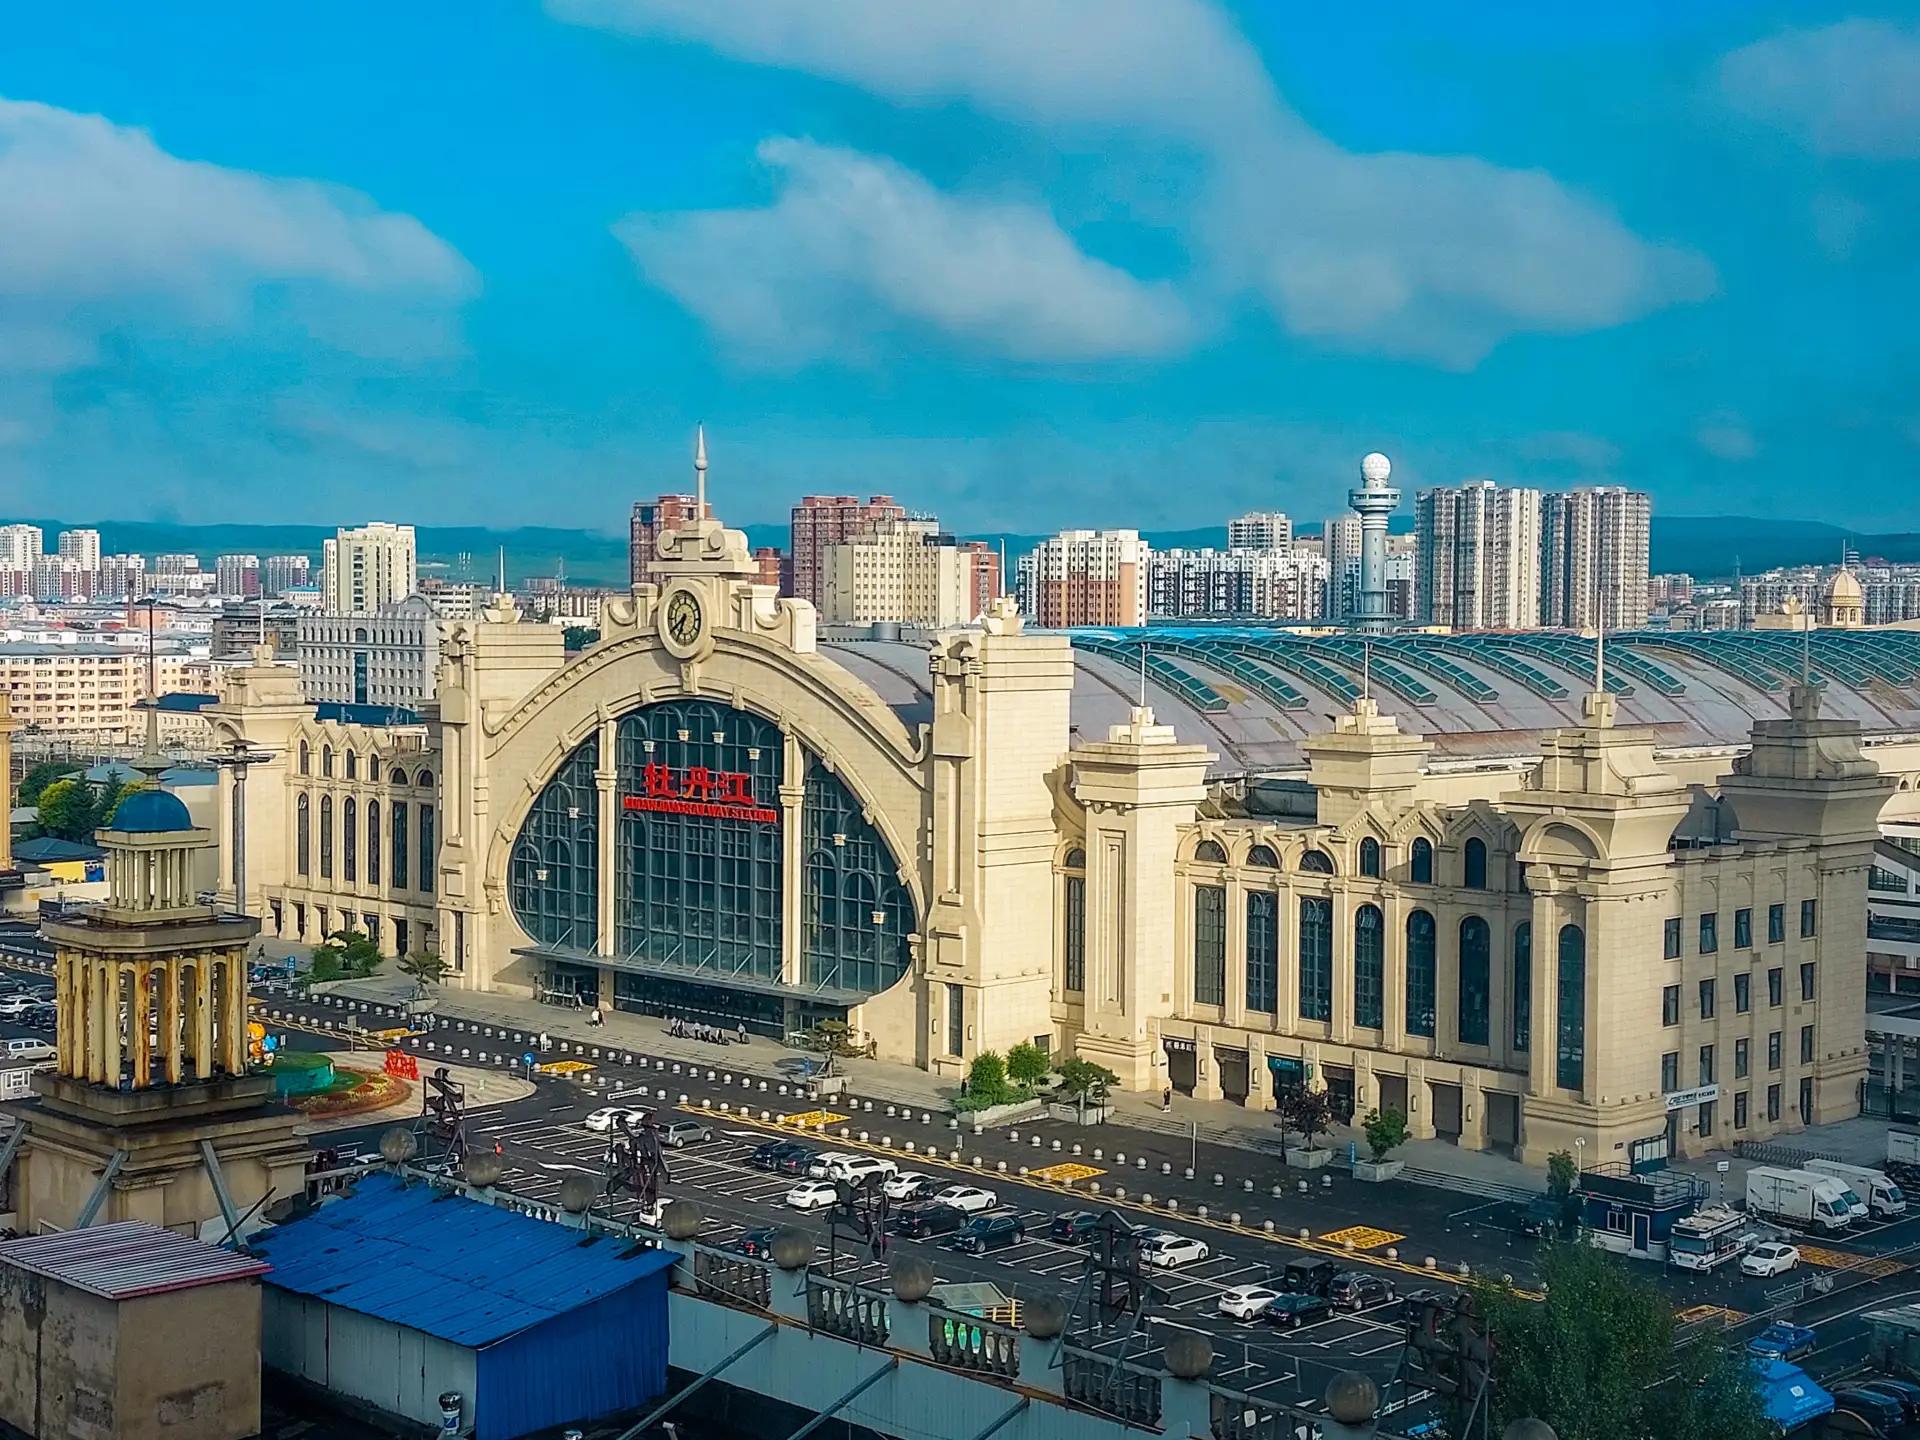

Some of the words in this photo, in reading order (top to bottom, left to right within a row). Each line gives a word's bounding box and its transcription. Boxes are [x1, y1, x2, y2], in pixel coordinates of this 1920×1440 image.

[643, 762, 755, 805] 牡丹江
[684, 802, 731, 818] RAILWAY
[731, 807, 777, 823] STATION
